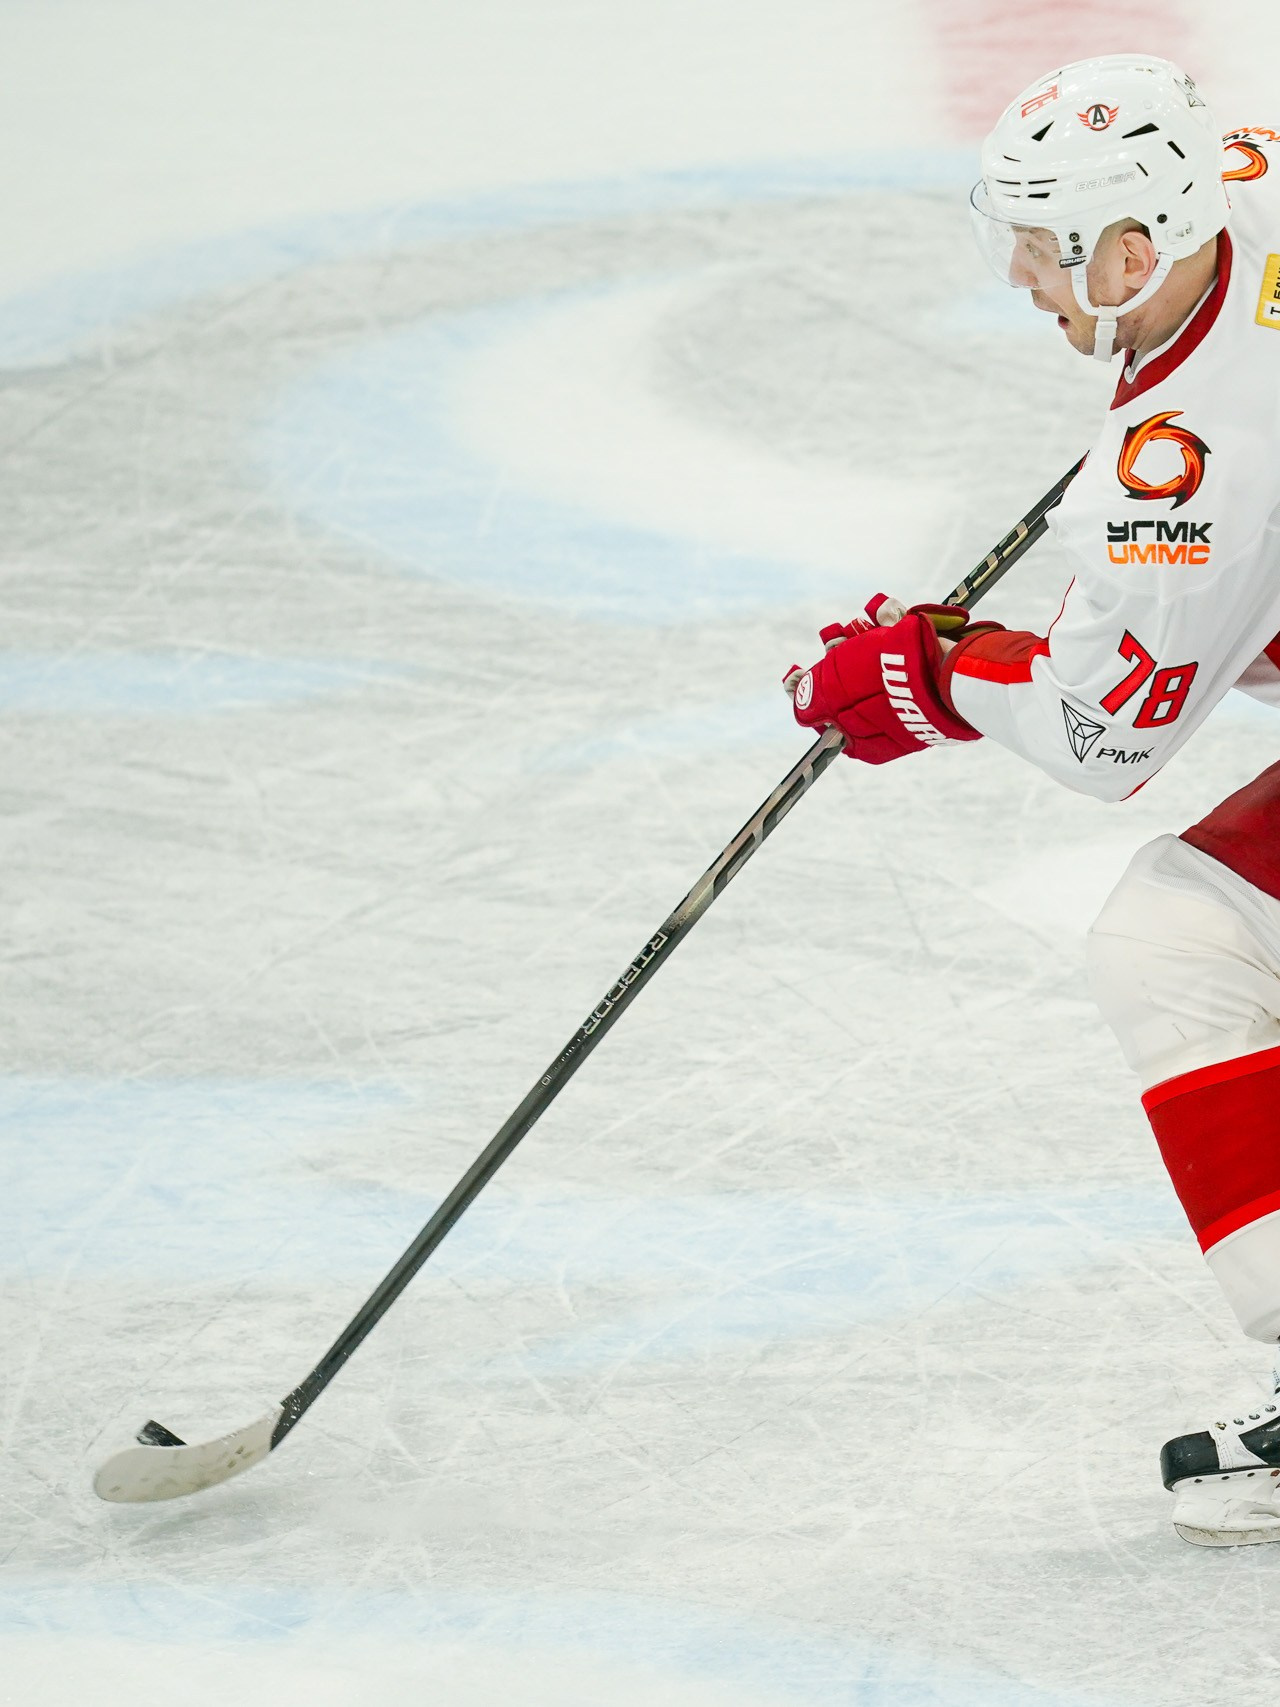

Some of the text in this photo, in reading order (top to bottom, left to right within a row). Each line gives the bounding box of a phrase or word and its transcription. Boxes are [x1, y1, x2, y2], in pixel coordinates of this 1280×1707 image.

[1075, 170, 1137, 193] BAUER
[1107, 520, 1214, 544] УГМК
[1107, 543, 1211, 565] UMMC
[1099, 628, 1199, 729] 78
[582, 930, 669, 1036] RIBCOR
